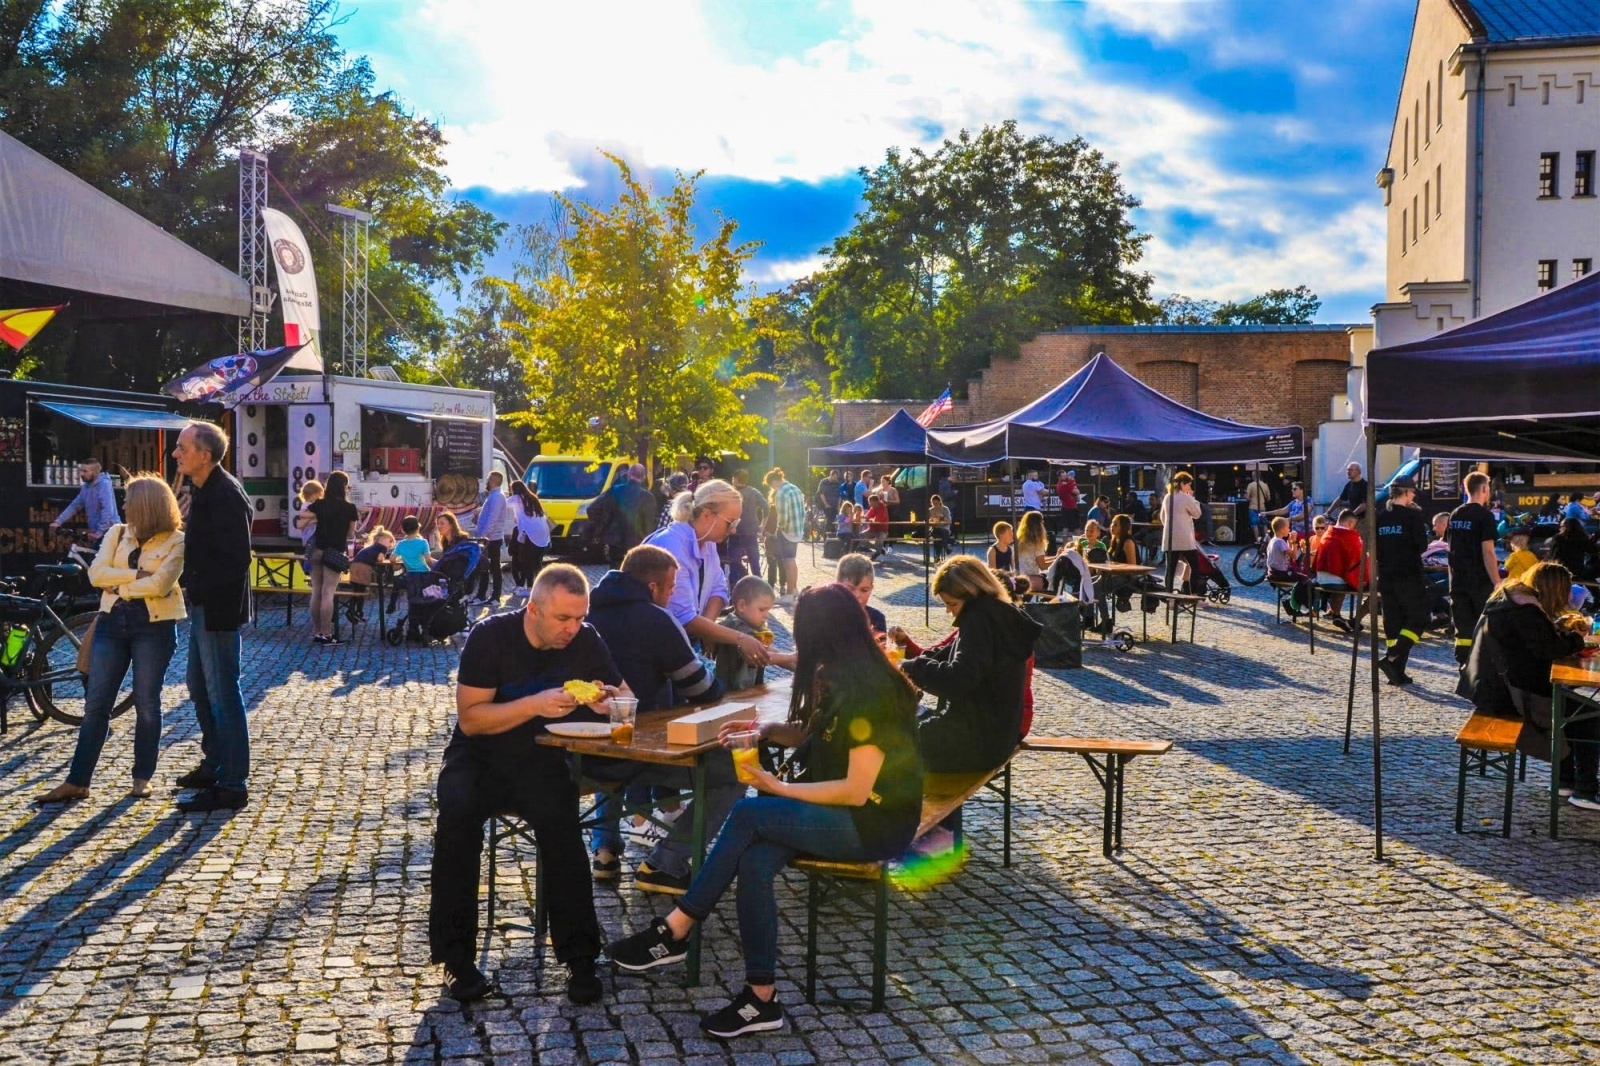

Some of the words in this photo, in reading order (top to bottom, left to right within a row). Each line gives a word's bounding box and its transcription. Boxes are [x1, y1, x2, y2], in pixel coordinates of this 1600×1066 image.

[253, 387, 270, 401] the
[273, 386, 311, 401] Street!
[338, 431, 360, 451] Eat
[1518, 495, 1541, 506] HOT
